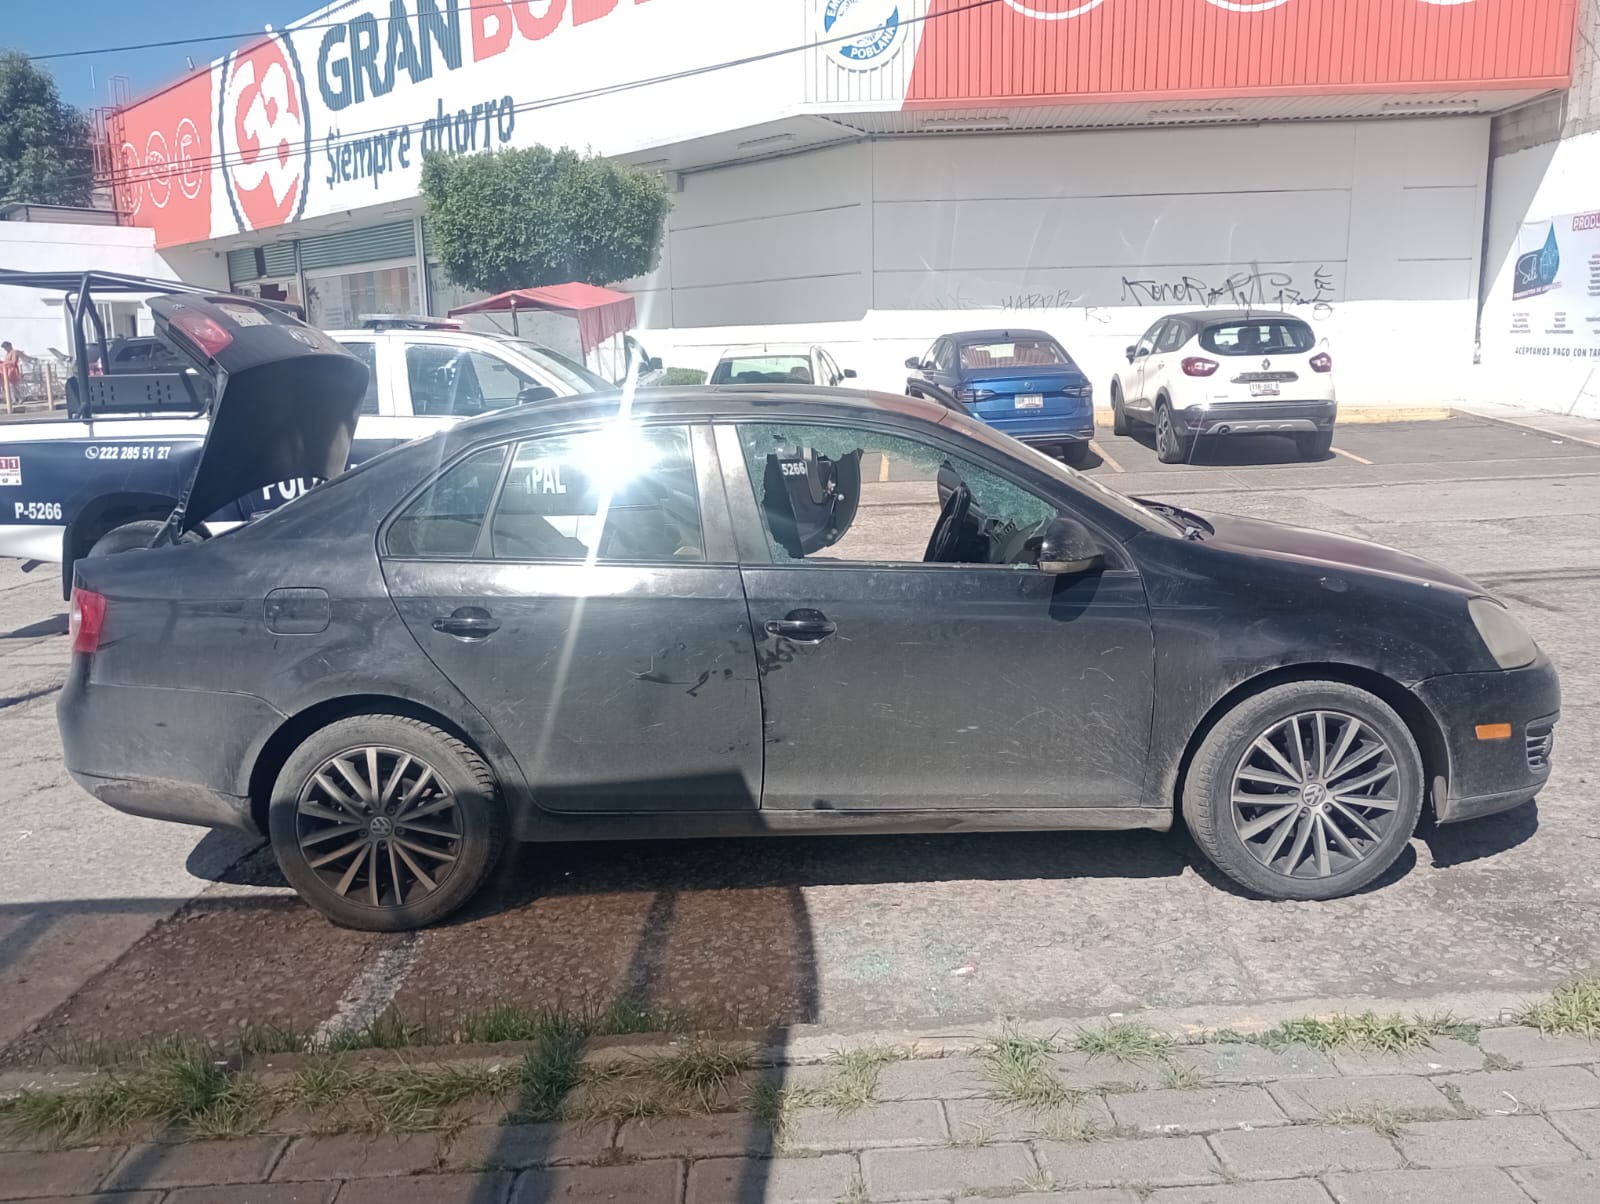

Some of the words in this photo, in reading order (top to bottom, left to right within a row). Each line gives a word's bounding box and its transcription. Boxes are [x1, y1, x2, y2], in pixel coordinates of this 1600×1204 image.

[850, 27, 896, 58] POBLANA
[317, 0, 463, 111] GRAN
[421, 95, 515, 157] ahorro
[1515, 346, 1550, 356] ACEPTAMOS
[1553, 347, 1570, 357] PAGO
[1573, 347, 1587, 358] CON
[100, 446, 118, 460] 222
[120, 446, 139, 460] 285
[142, 446, 154, 460] 51
[157, 446, 171, 460] 27
[781, 461, 807, 476] 5266
[15, 502, 62, 520] P-5266
